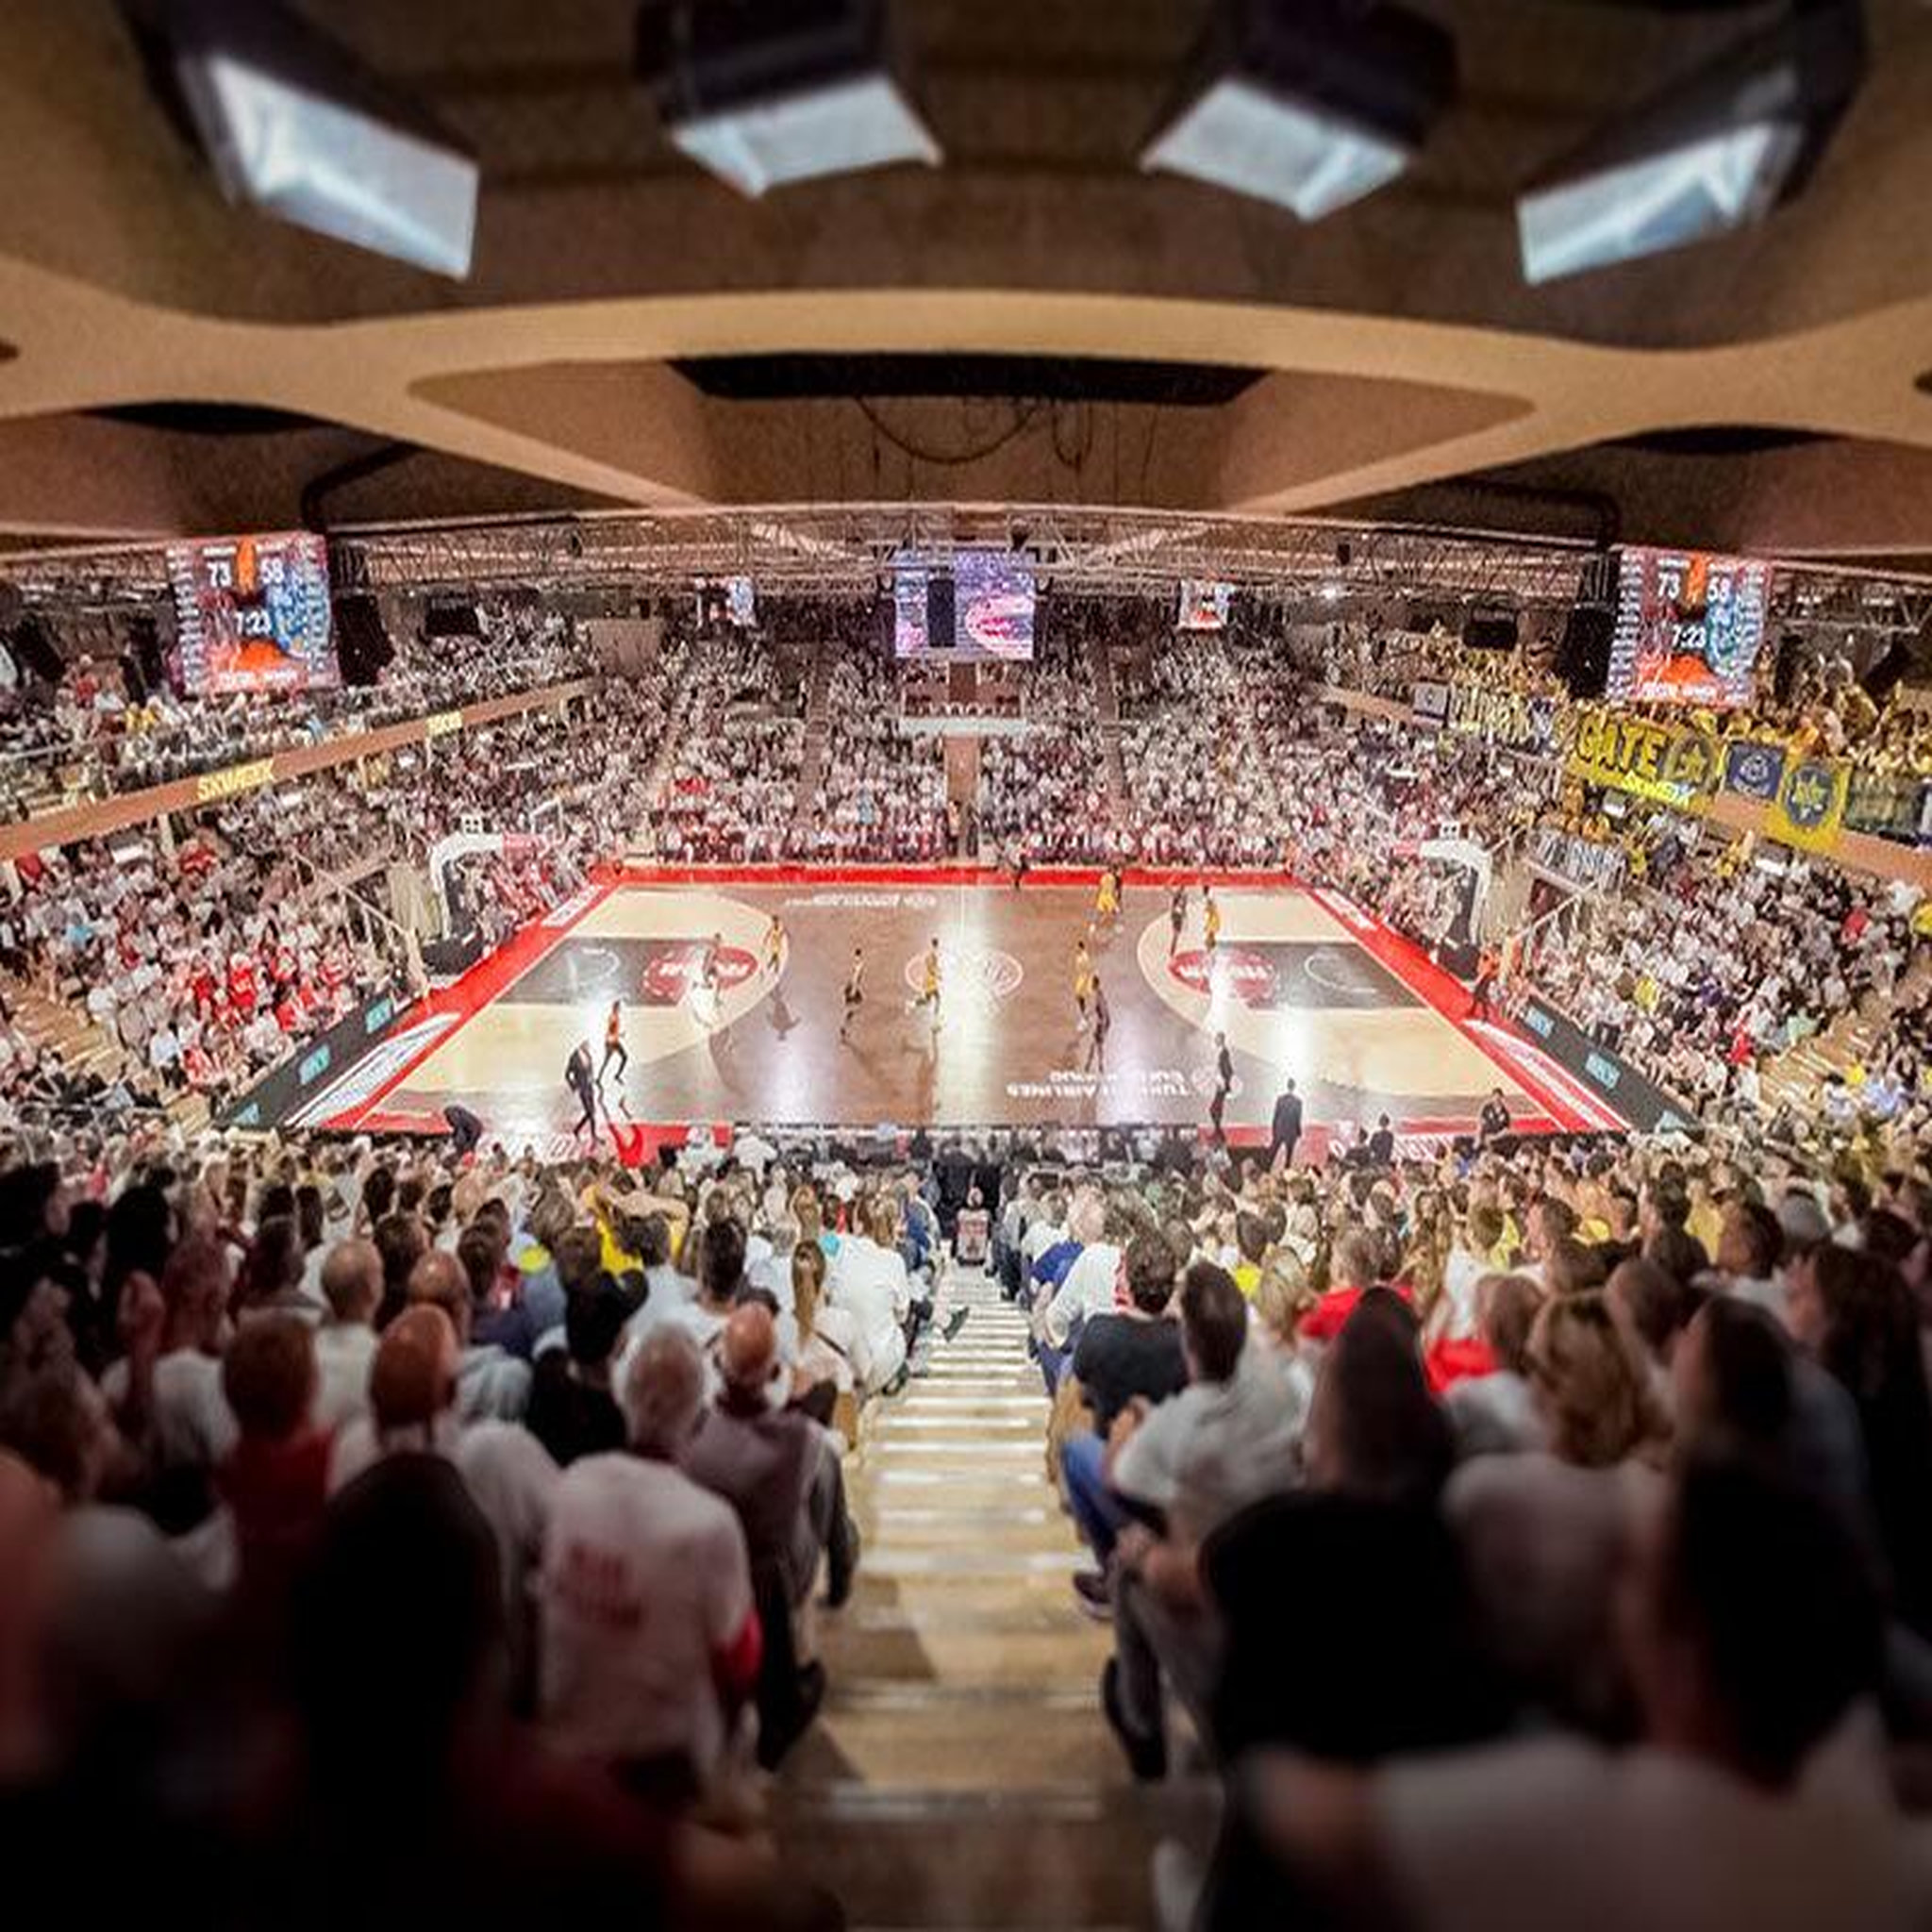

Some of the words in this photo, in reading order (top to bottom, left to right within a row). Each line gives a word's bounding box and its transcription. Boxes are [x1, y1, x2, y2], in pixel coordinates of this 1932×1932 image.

[207, 560, 232, 588] 73
[1657, 572, 1680, 599] 73
[1576, 713, 1670, 779] GATE
